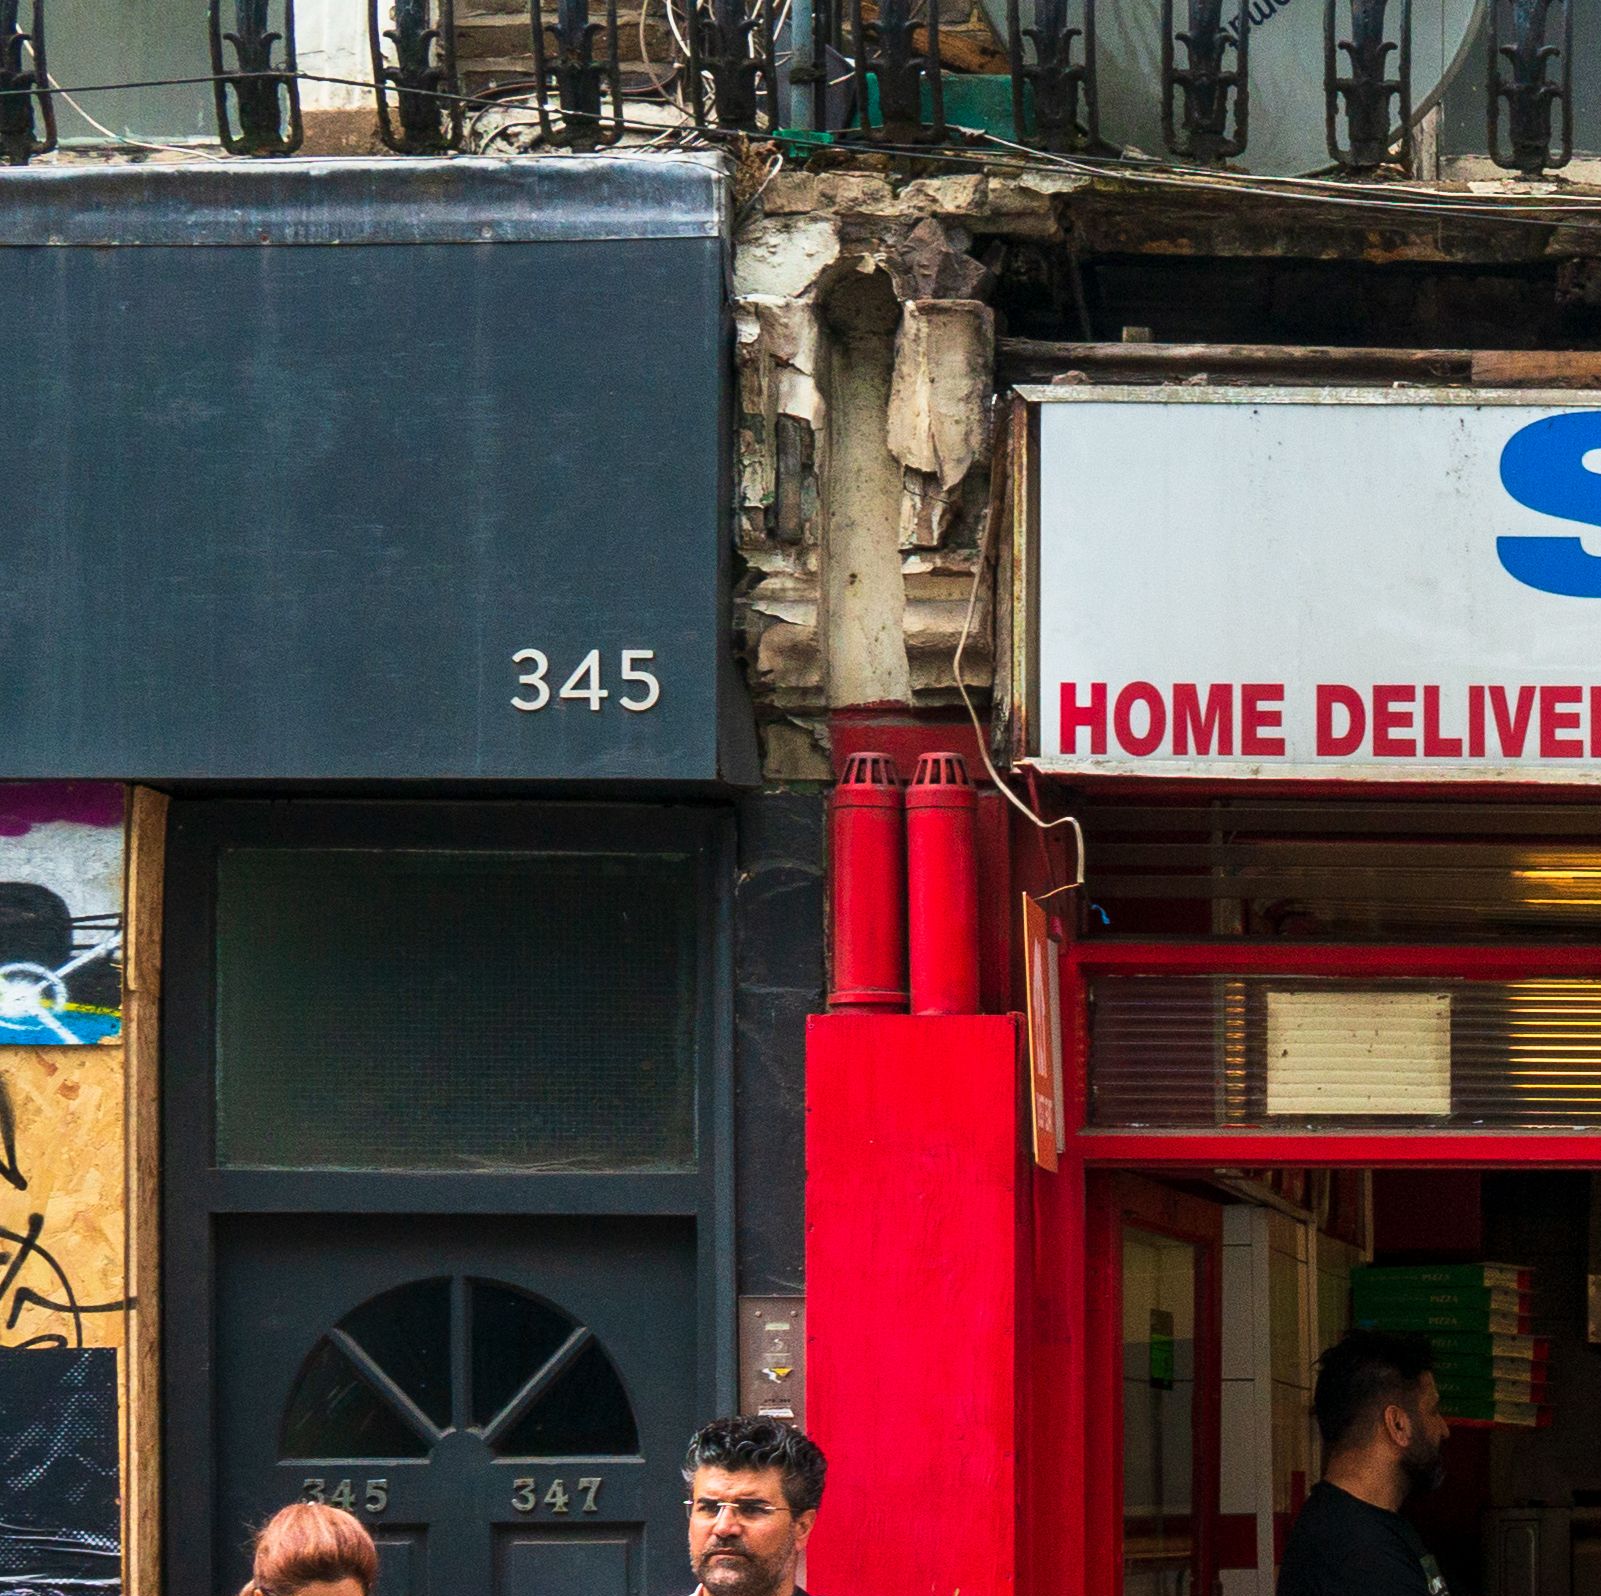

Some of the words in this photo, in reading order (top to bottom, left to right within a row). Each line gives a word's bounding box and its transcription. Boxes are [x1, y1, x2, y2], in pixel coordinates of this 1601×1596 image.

[511, 649, 659, 710] 345
[1059, 682, 1284, 756] HOME
[303, 1478, 388, 1512] 345
[511, 1477, 602, 1512] 347
